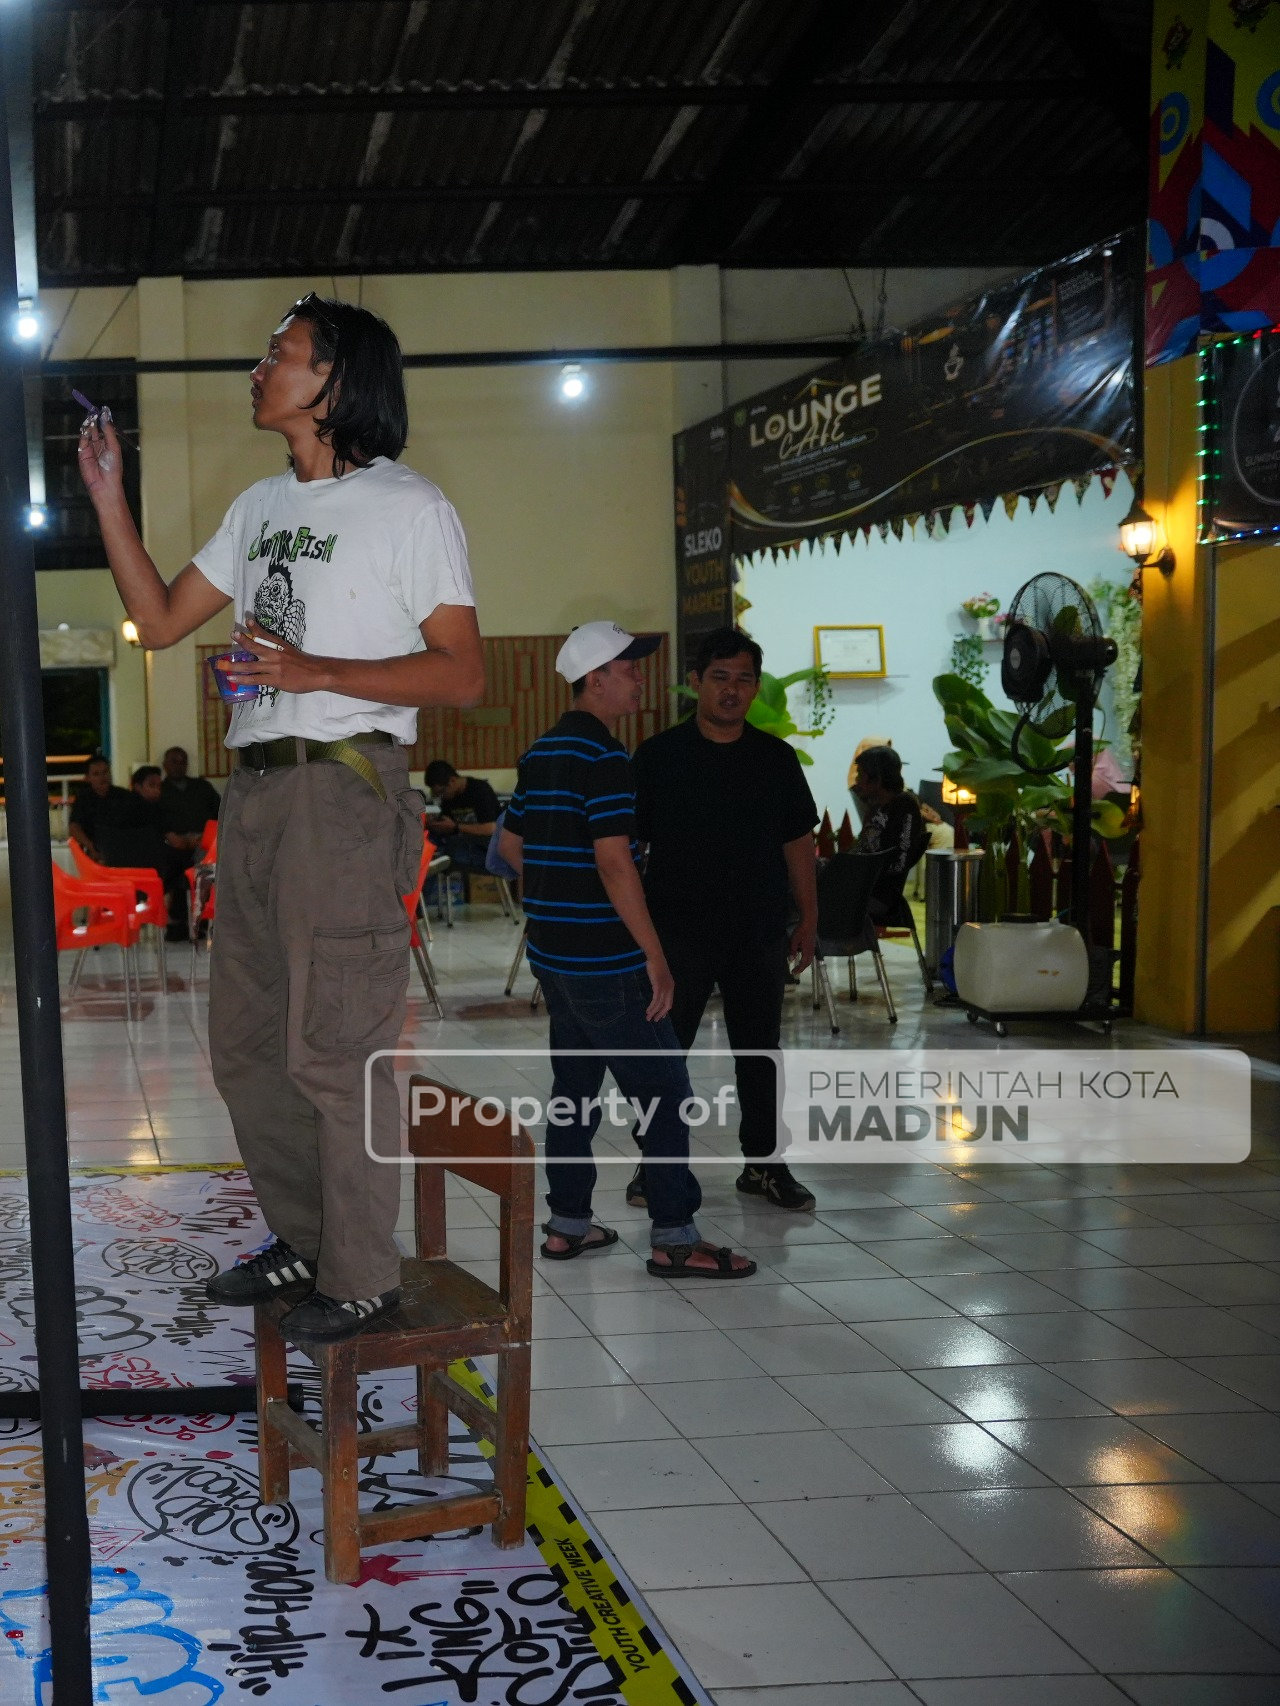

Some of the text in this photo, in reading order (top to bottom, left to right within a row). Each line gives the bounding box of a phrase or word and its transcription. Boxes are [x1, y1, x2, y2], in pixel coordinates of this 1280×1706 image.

[750, 373, 882, 448] LOUNGE
[684, 526, 722, 558] SLEKO
[554, 1536, 651, 1673] YOUTH CREATIVE WEEK
